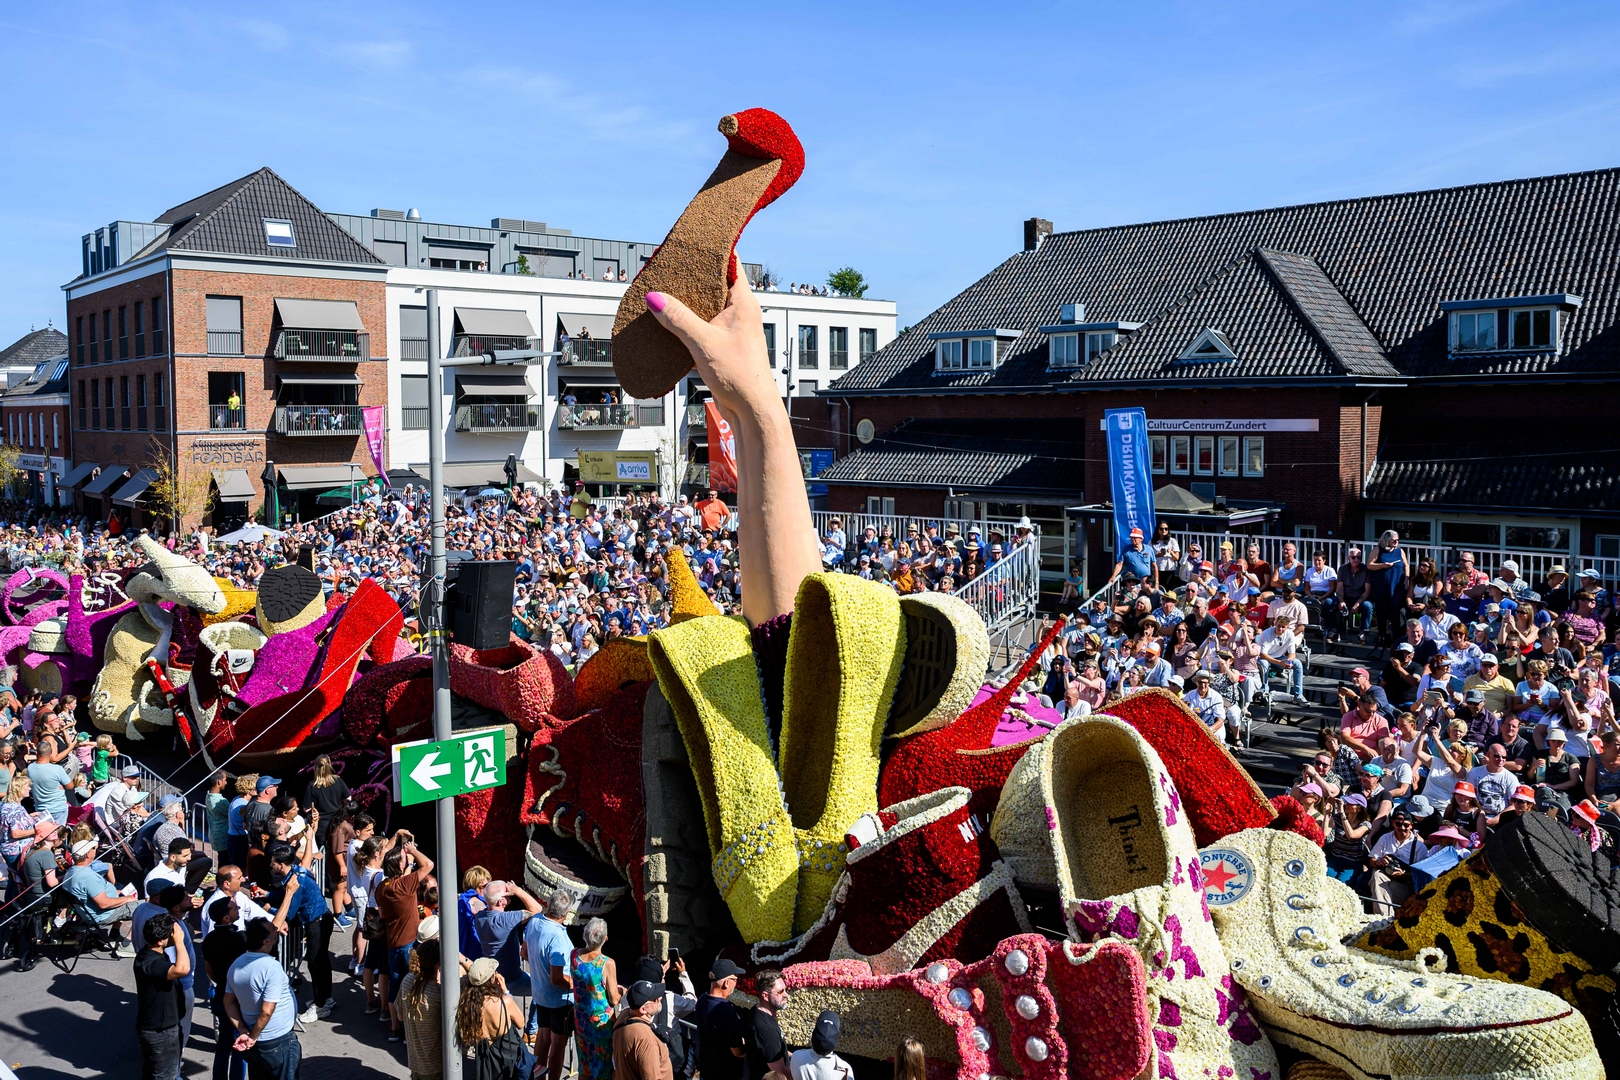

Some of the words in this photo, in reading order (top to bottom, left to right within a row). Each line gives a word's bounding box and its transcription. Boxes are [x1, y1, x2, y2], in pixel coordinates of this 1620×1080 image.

[1147, 420, 1267, 430] CultuurCentrumZundert
[193, 452, 264, 464] FOODBAR
[627, 464, 648, 474] arriva
[1108, 804, 1148, 875] Think!
[1201, 854, 1247, 875] ONVERSE
[590, 893, 607, 909] ALL
[1206, 891, 1236, 901] STAR
